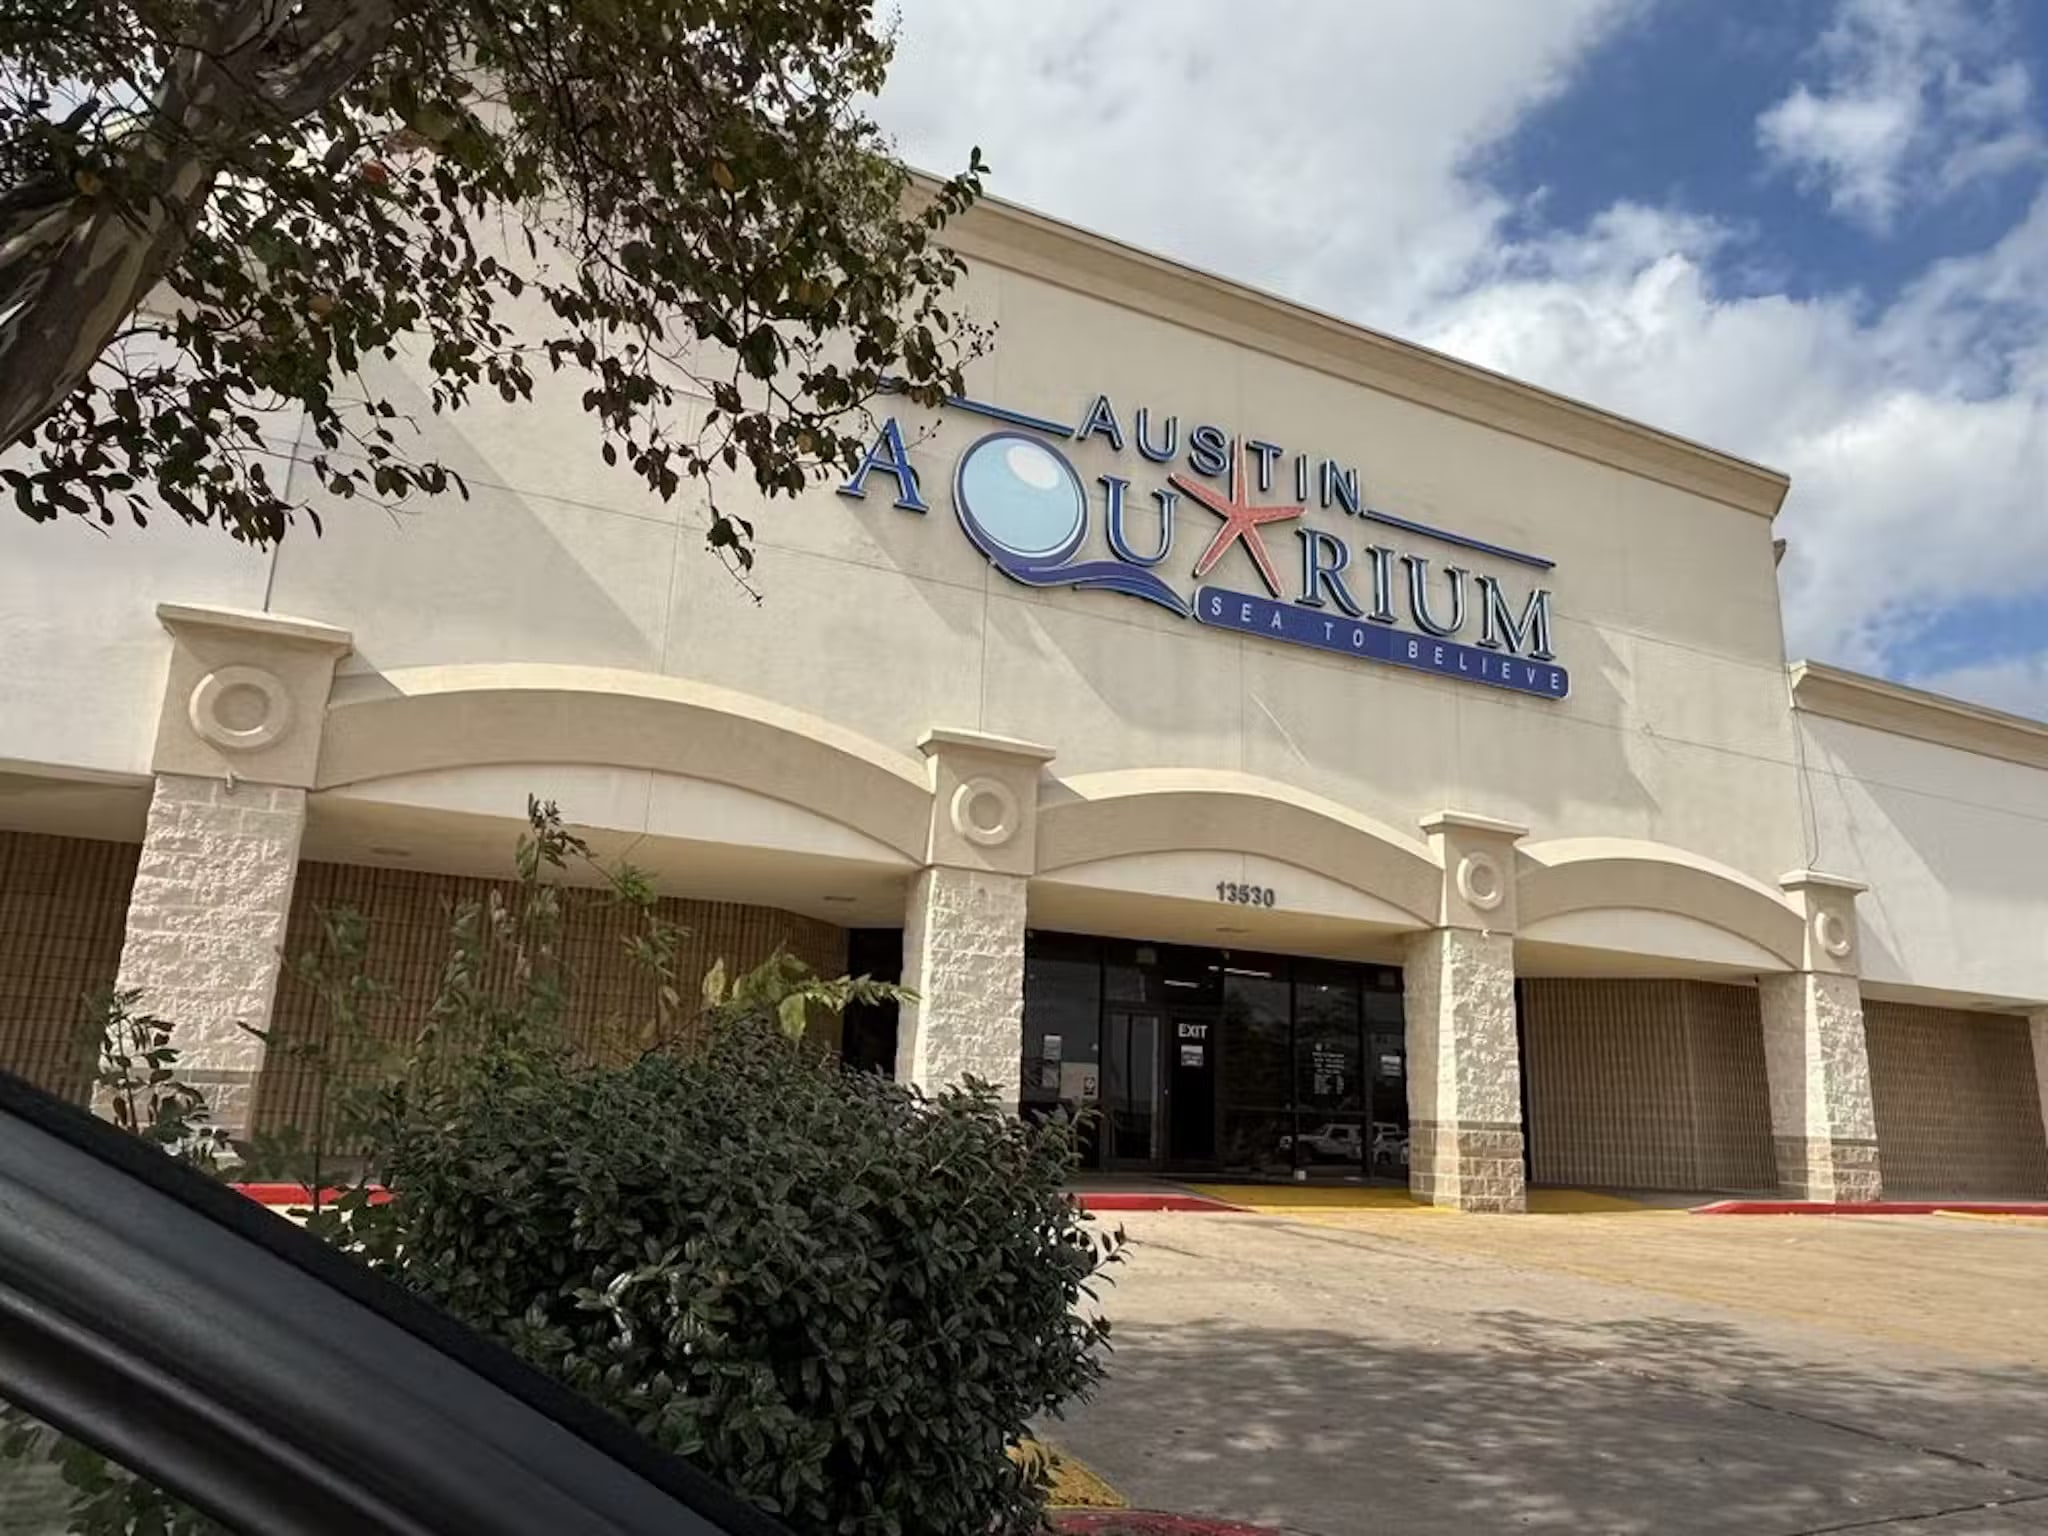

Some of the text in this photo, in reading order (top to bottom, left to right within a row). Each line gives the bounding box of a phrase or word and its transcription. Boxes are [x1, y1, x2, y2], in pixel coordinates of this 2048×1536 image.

[1076, 394, 1362, 515] AUSTIN
[1210, 597, 1560, 690] SEA TO BELIEVE
[1216, 881, 1275, 907] 13530
[1178, 1023, 1208, 1039] EXIT
